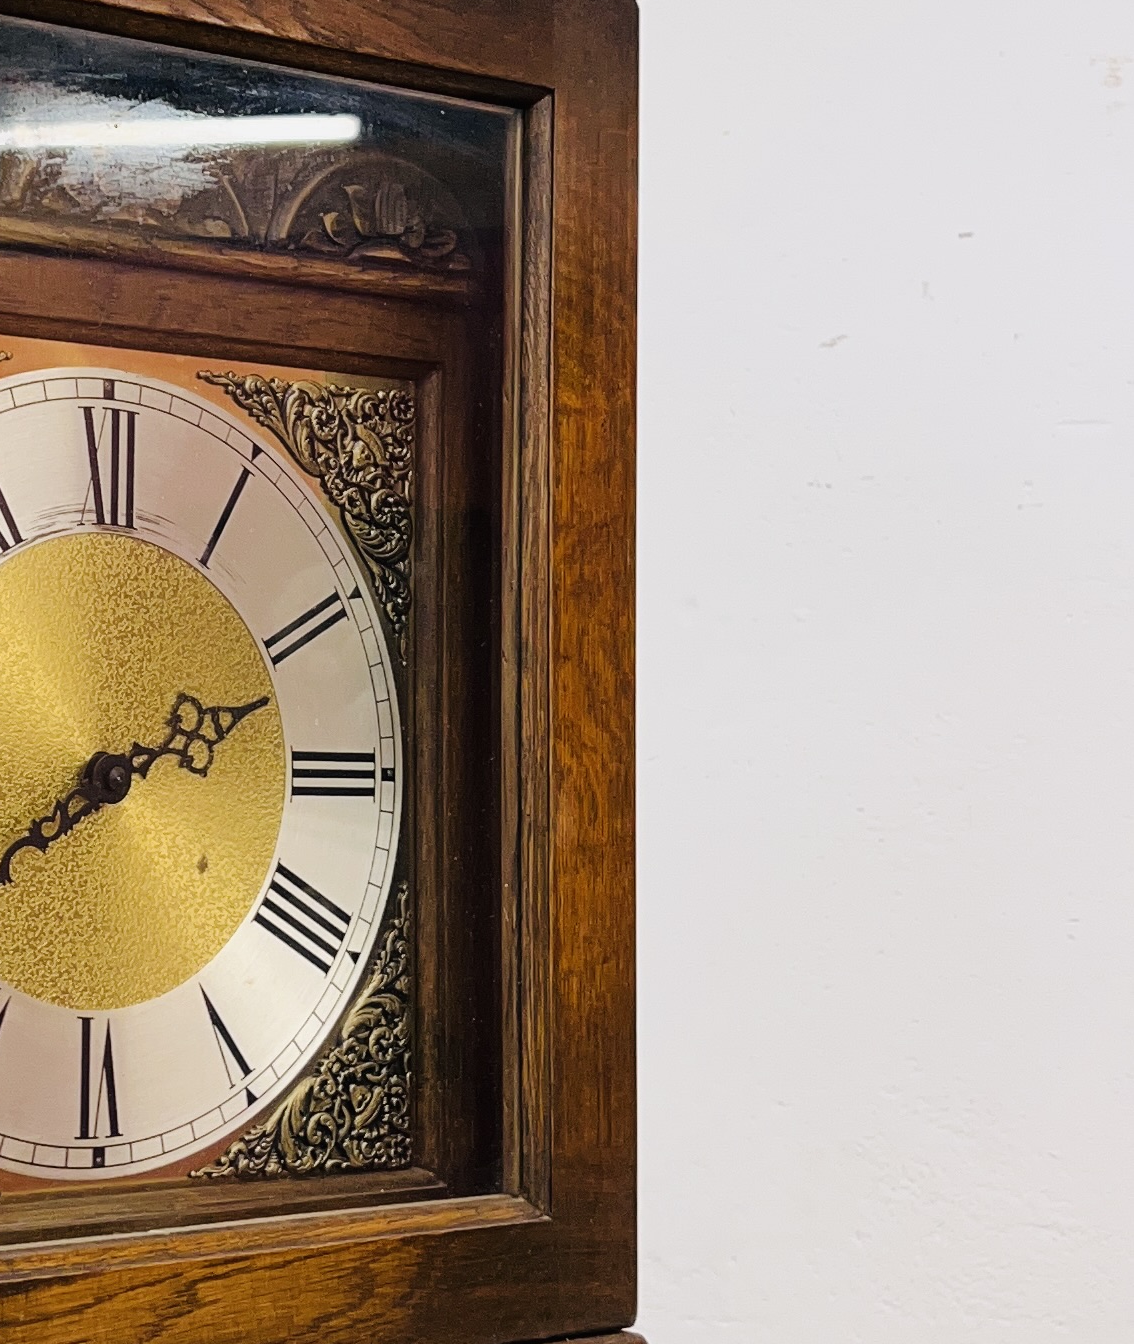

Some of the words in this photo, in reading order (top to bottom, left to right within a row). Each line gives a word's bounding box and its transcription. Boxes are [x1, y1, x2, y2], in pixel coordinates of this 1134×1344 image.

[77, 406, 139, 530] XII
[195, 464, 255, 570] I
[261, 586, 349, 672] II
[290, 745, 376, 803] III
[250, 857, 354, 979] IIII
[74, 1016, 123, 1140] VI
[199, 983, 255, 1090] V
